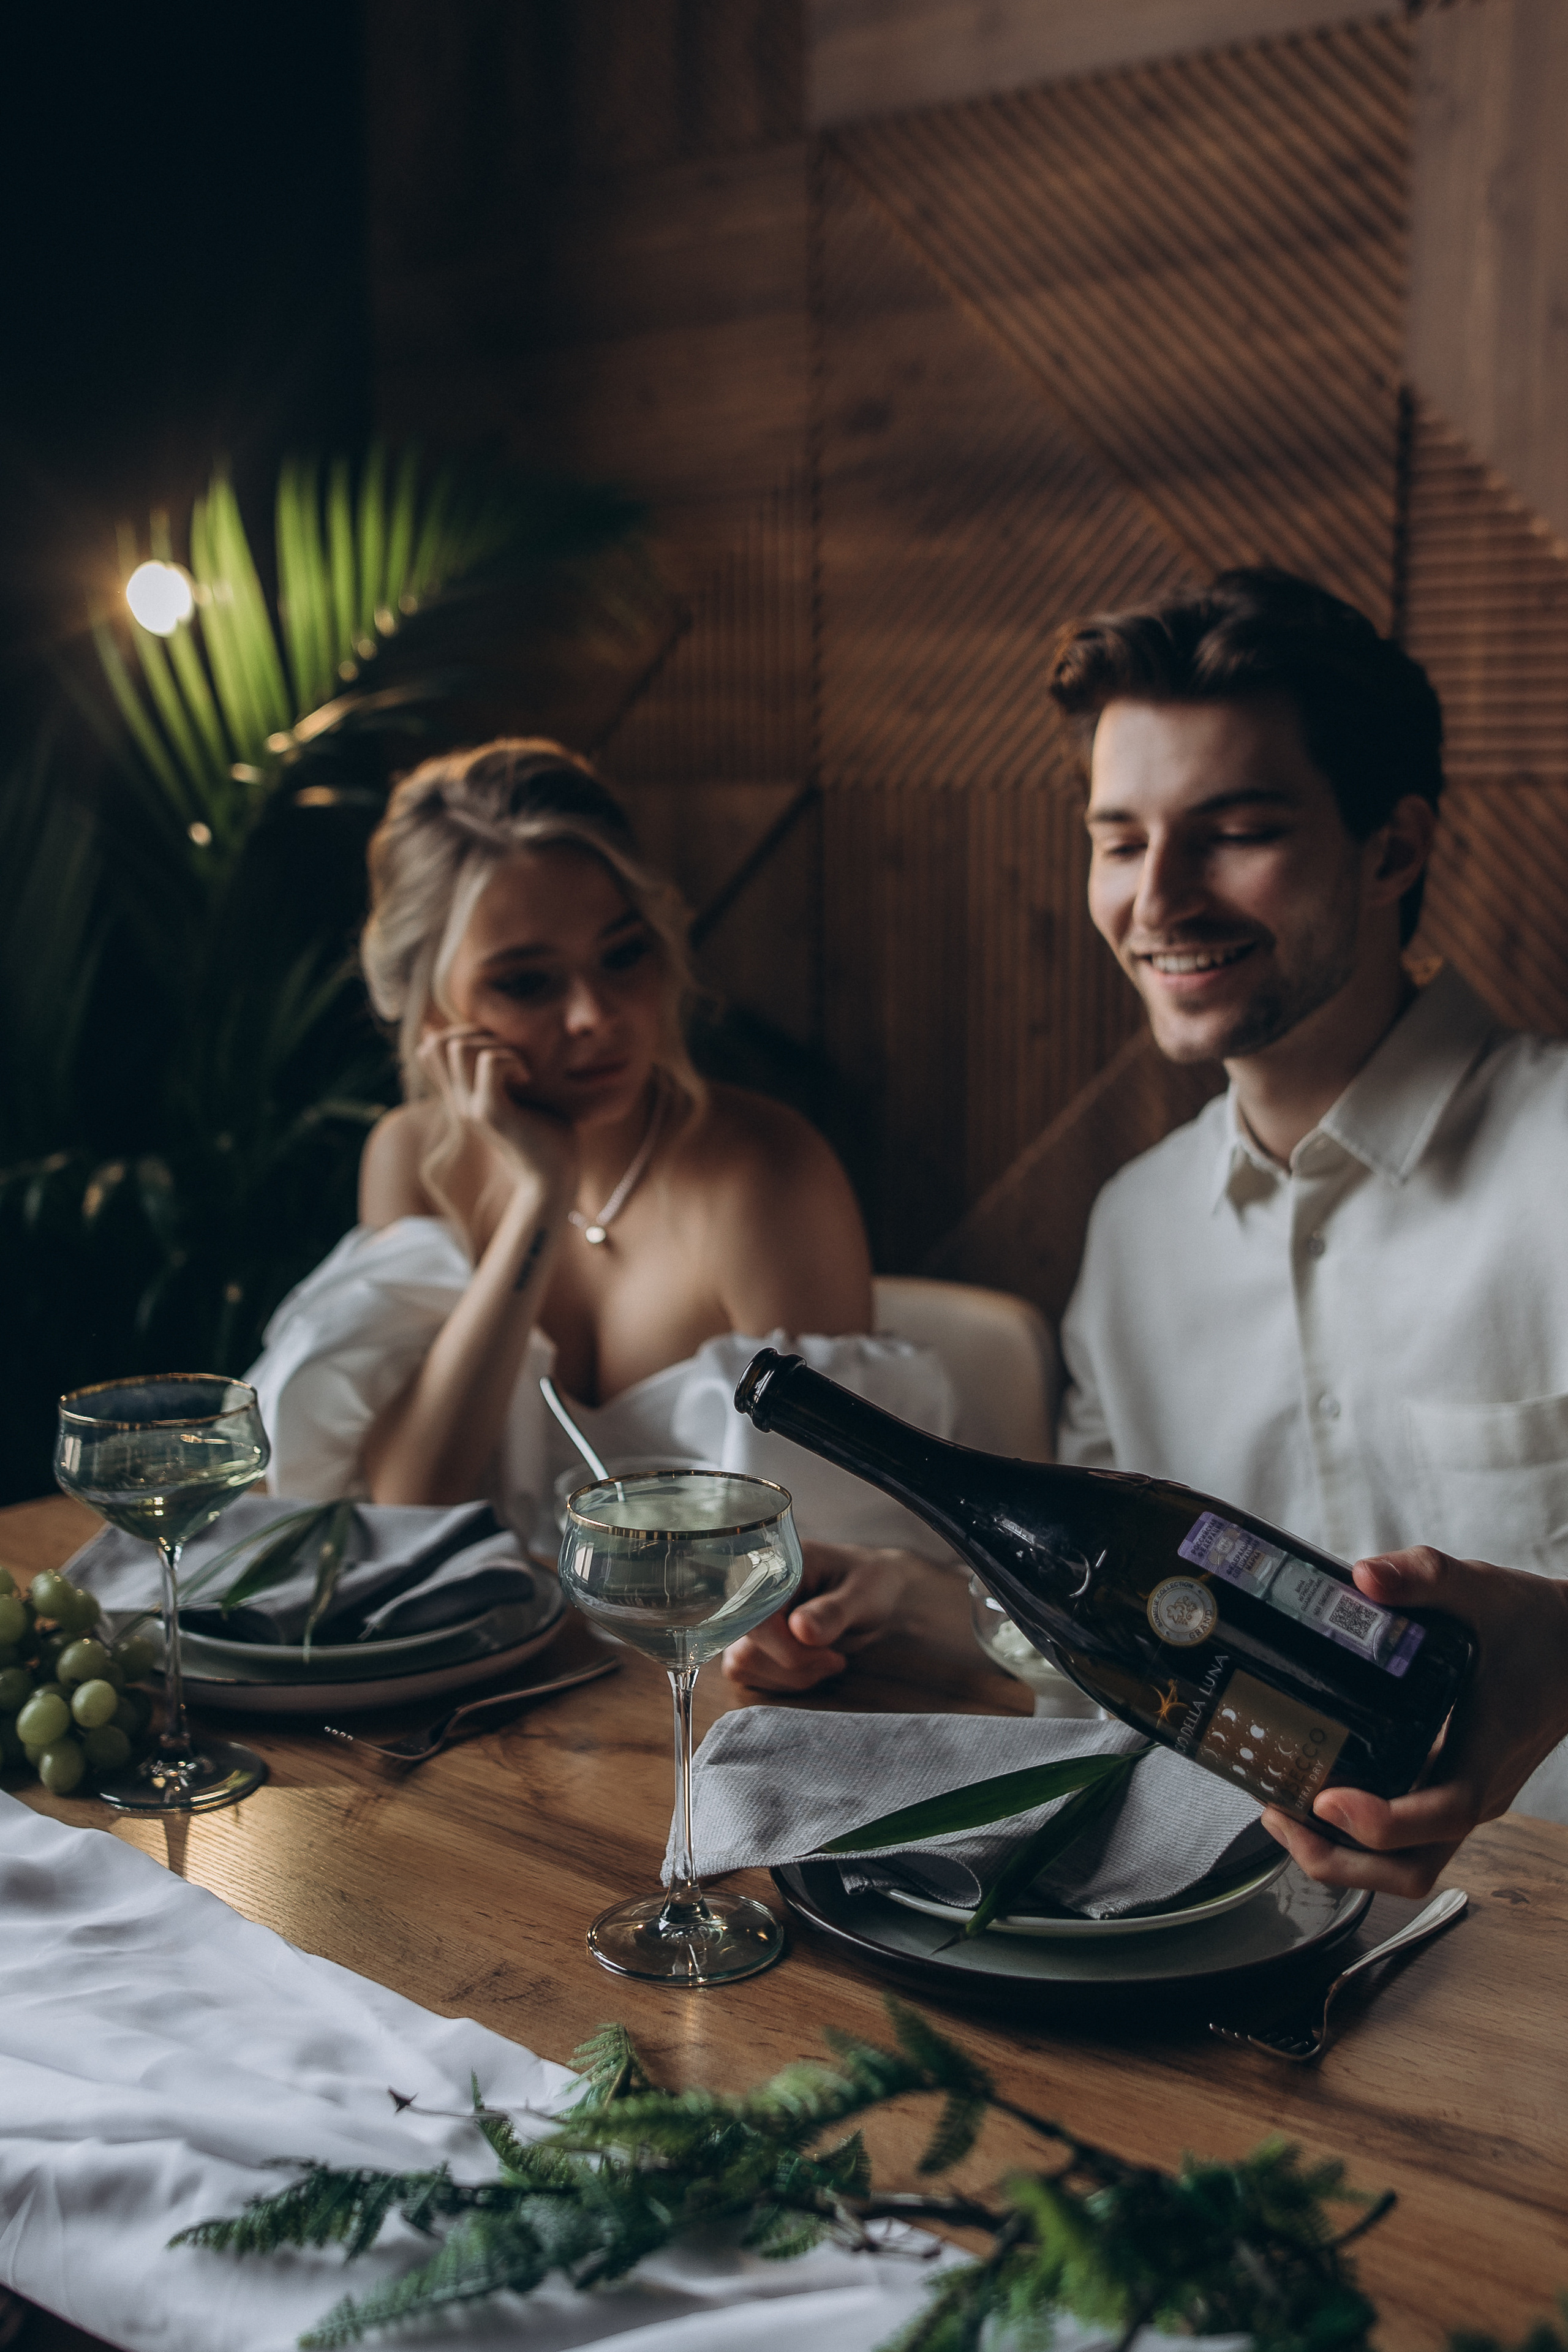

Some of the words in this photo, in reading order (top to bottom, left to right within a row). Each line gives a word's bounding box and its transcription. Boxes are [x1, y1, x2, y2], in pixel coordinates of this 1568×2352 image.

[1190, 1518, 1217, 1555] РОССИЙСКАЯ
[1196, 1521, 1223, 1558] ФЕДЕРАЦИЯ
[1227, 1535, 1253, 1575] ФЕДЕРАЛЬНАЯ
[1233, 1539, 1261, 1579] СПЕЦИАЛЬНАЯ
[1245, 1550, 1261, 1571] МАРКА
[1156, 1581, 1194, 1599] COLLECTION
[1152, 1599, 1163, 1627] SOMELIE
[1188, 1609, 1211, 1638] GRAND
[1180, 1702, 1205, 1737] DELLA
[1198, 1656, 1229, 1696] LUNA
[1294, 1784, 1312, 1809] EXTRA
[1308, 1758, 1323, 1781] DRY
